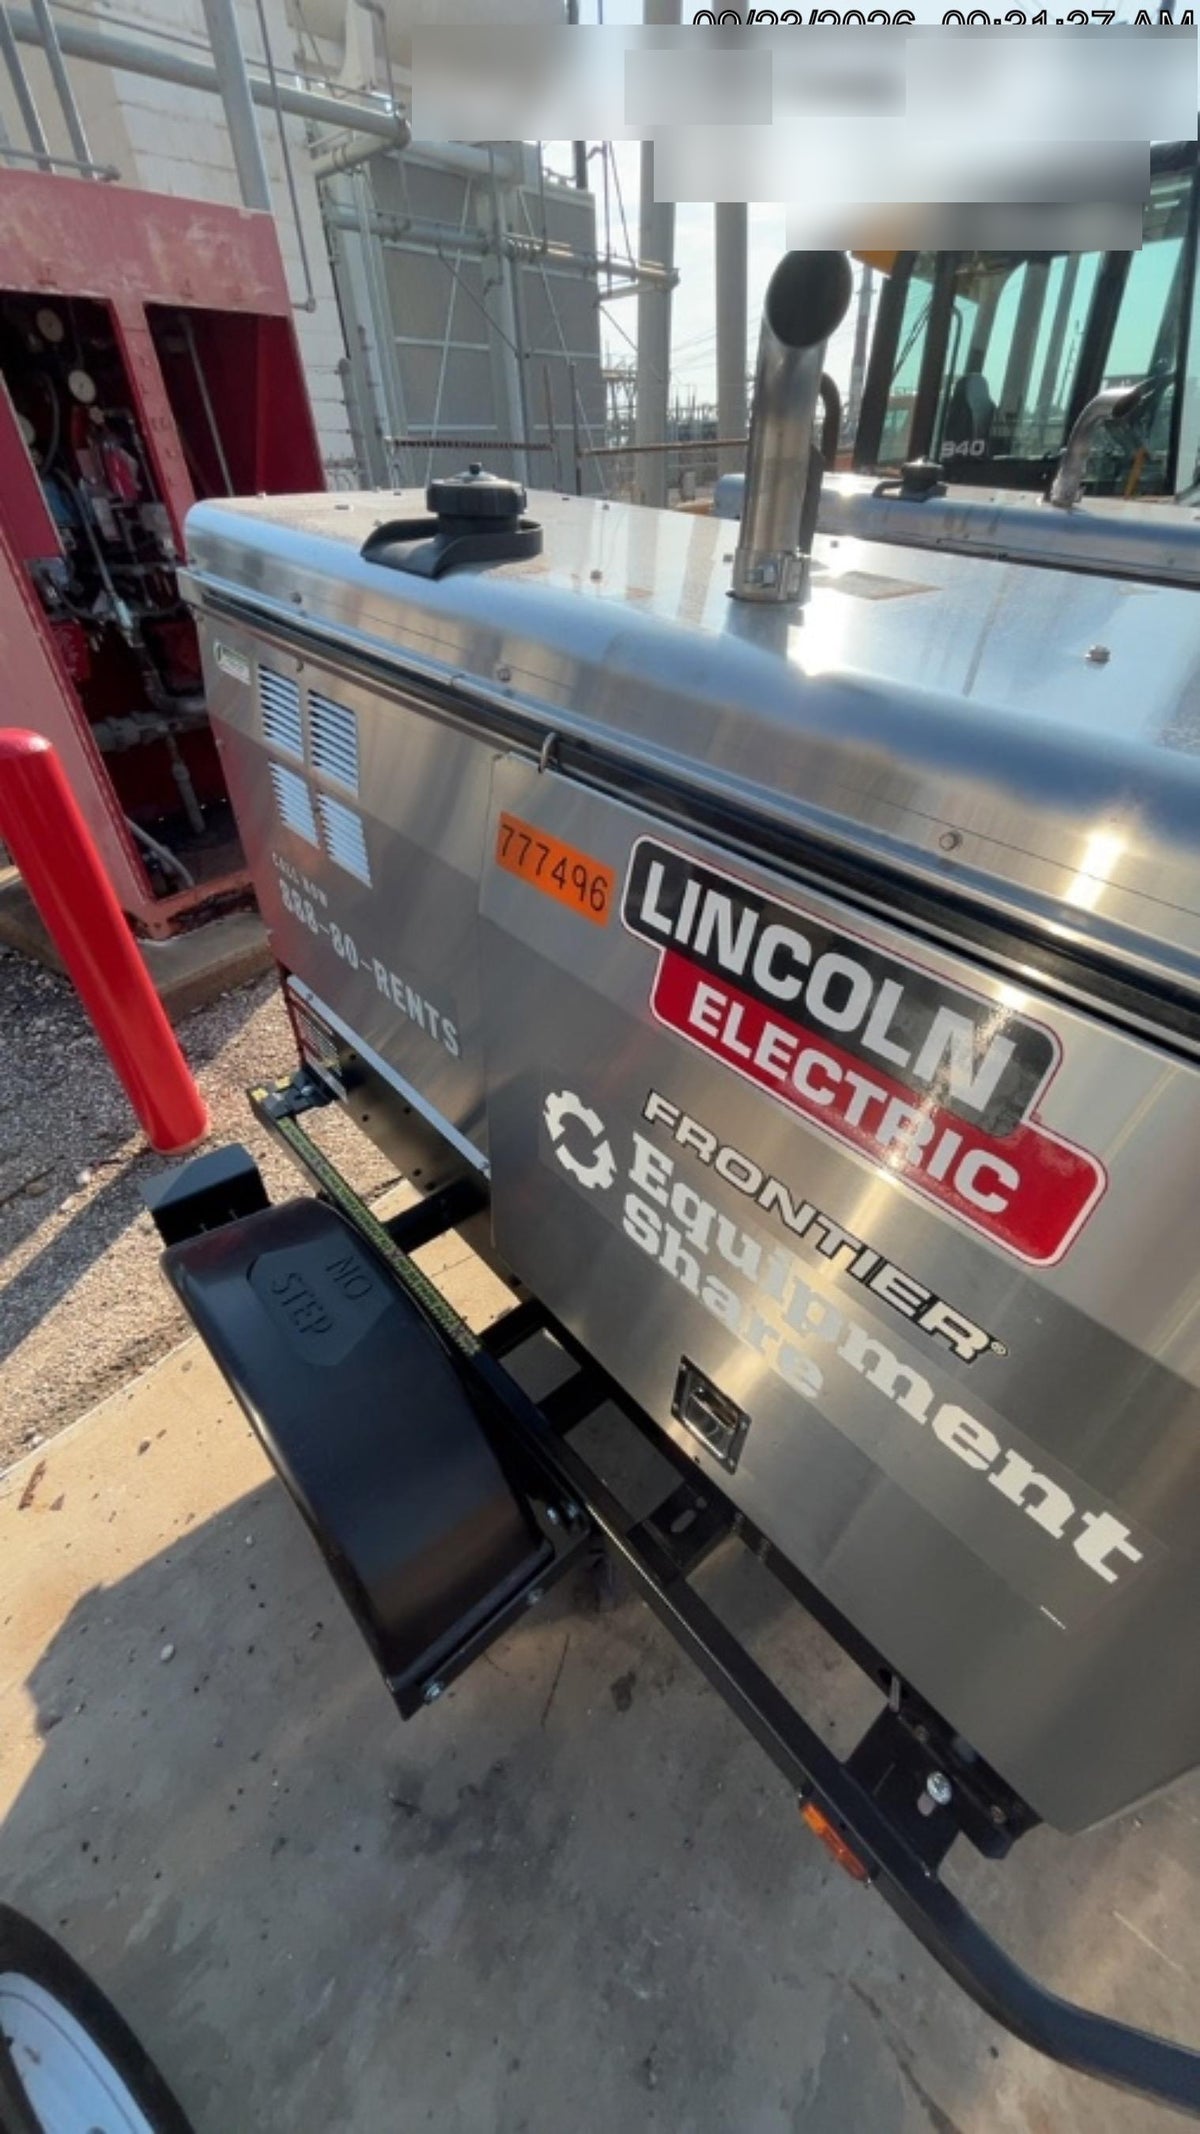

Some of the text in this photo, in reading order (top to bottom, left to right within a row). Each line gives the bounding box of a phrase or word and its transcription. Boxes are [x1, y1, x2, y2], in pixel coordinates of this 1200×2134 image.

[501, 823, 607, 912] 777496
[639, 860, 1016, 1112] LINCOLN
[688, 981, 1020, 1214] ELECTRIC
[270, 1272, 335, 1334] STEP
[325, 1255, 374, 1300] NO
[622, 1191, 825, 1399] Share
[629, 1131, 1143, 1584] Equipment
